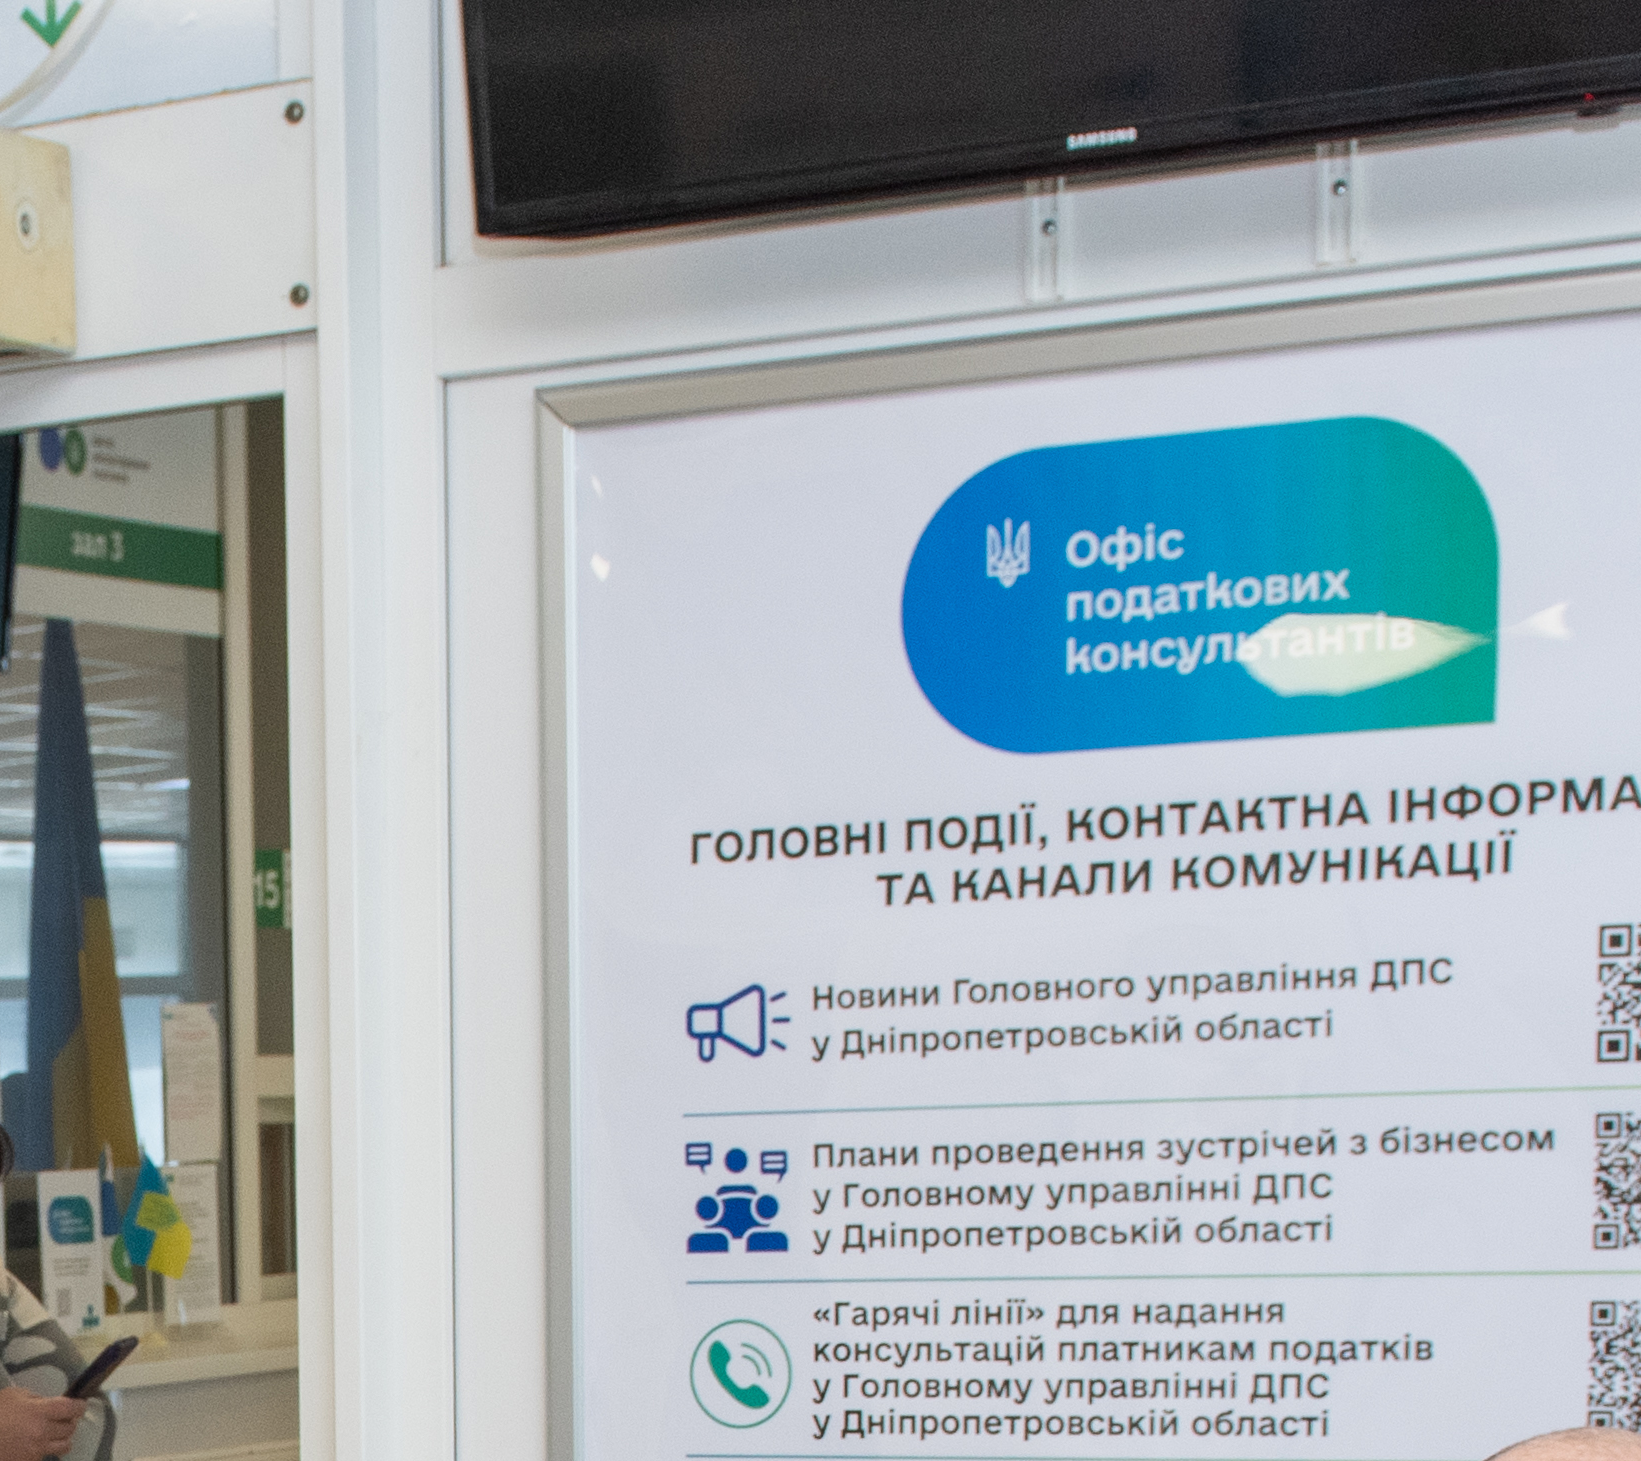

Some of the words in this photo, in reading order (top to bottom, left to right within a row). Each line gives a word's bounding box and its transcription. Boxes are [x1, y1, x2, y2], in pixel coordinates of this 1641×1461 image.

[1066, 126, 1138, 152] SAMSUNG
[71, 530, 108, 559] зал
[110, 529, 125, 562] 3
[1064, 522, 1185, 573] Офіс
[1065, 568, 1350, 624] податкових
[1066, 611, 1418, 676] консультантів
[691, 820, 886, 865] ГОЛОВНІ
[905, 802, 1048, 856] ПОДІЇ,
[1067, 791, 1370, 843] КОНТАКТНА
[253, 869, 280, 909] 15
[876, 871, 936, 907] ТА
[953, 859, 1151, 903] КАНАЛИ
[1171, 828, 1517, 891] КОМУНІКАЦІЇ
[812, 984, 940, 1011] Новини
[953, 976, 1135, 1005] Головного
[1146, 962, 1357, 1004] управління
[1369, 956, 1452, 993] ДПС
[811, 1035, 831, 1063] у
[840, 1015, 1183, 1060] Дніпропетровській
[1195, 1009, 1333, 1042] області
[813, 1142, 919, 1169] Плани
[931, 1139, 1144, 1172] проведення
[1157, 1128, 1337, 1167] зустрічей
[1349, 1133, 1368, 1156] з
[1379, 1125, 1554, 1155] бізнесом
[812, 1188, 831, 1216] у
[843, 1183, 1034, 1213] Головному
[1045, 1173, 1240, 1212] управлінні
[1252, 1171, 1333, 1206] ДПС
[812, 1229, 831, 1255] у
[841, 1216, 1182, 1255] Дніпропетровській
[1195, 1213, 1333, 1244] області
[812, 1299, 939, 1333] «Гарячі
[950, 1298, 1045, 1326] лінії»
[1055, 1303, 1120, 1330] для
[1133, 1302, 1285, 1329] надання
[813, 1334, 1045, 1369] консультацій
[1057, 1340, 1255, 1362] платникам
[1269, 1333, 1433, 1366] податків
